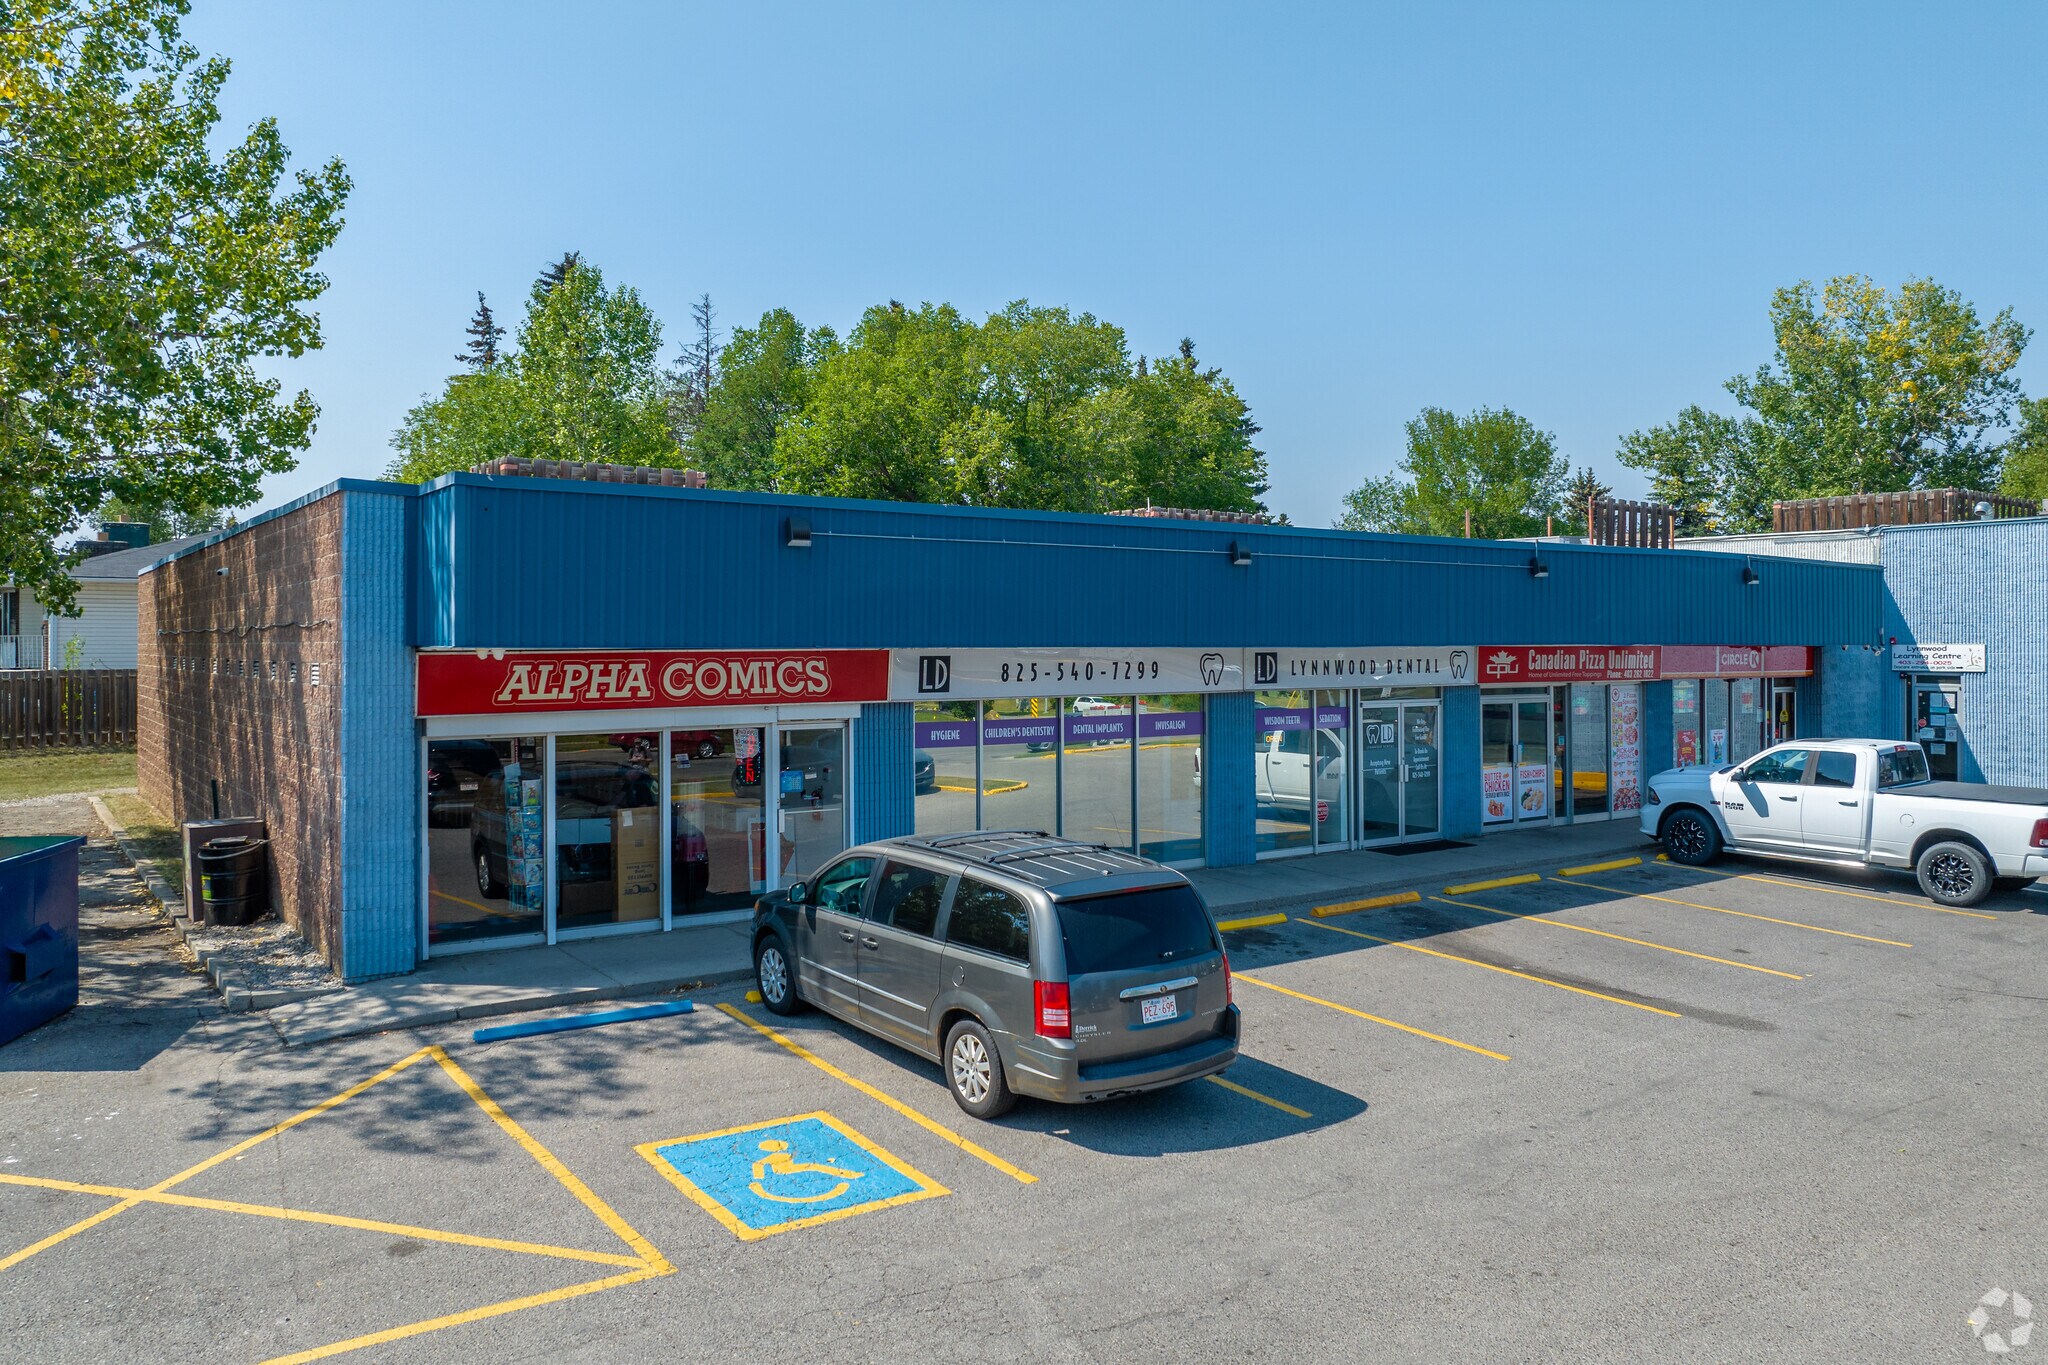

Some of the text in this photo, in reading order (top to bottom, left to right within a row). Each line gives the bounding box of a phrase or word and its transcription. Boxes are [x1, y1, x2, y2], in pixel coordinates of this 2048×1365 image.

[1907, 645, 1947, 653] Lynnwood
[1528, 649, 1654, 670] Canadian Pizza Unlimited
[1721, 651, 1759, 668] CIRCLE K
[1893, 652, 1929, 660] Learning
[1001, 661, 1159, 683] 825-540-7299
[1257, 654, 1276, 681] LD
[1291, 659, 1440, 676] LYNNWOOD DENTAL
[497, 660, 829, 701] ALPHA COMICS
[922, 659, 949, 690] LD
[1582, 671, 1602, 679] Toppings
[1606, 670, 1622, 679] Phone:
[1155, 719, 1186, 730] INVISALIGN
[1264, 715, 1301, 726] WISDOM TEETH
[1319, 714, 1342, 723] SEDATION
[984, 725, 1055, 739] CHILDREN'S DENTISTRY
[1072, 722, 1124, 735] DENTAL IMPLANTS
[931, 729, 960, 741] HYGIENE
[745, 735, 755, 782] OPEN
[1484, 772, 1502, 781] BUTTER
[1484, 780, 1510, 792] CHICKEN
